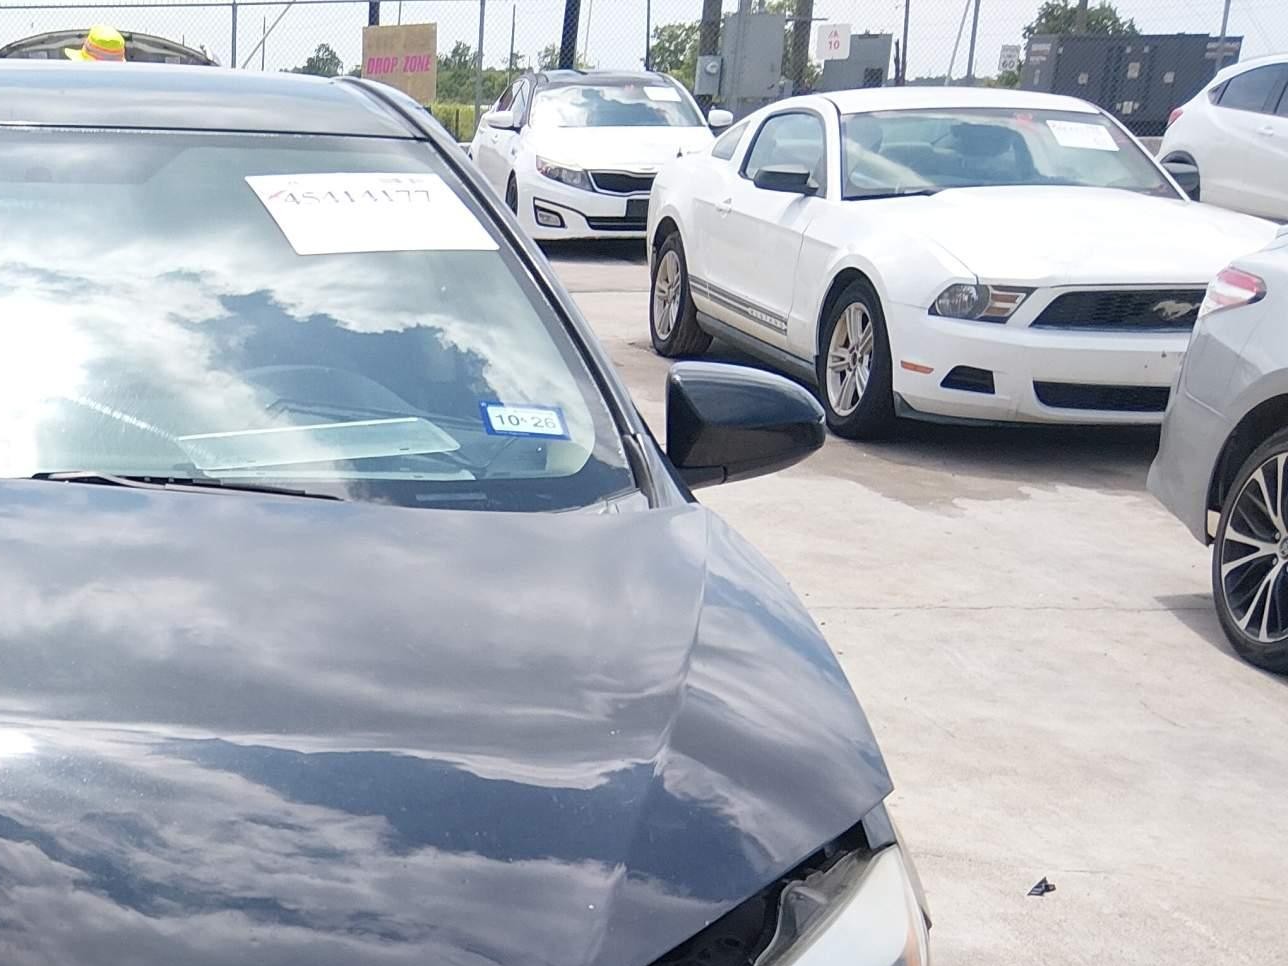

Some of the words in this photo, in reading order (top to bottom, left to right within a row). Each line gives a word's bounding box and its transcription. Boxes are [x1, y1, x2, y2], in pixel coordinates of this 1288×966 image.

[828, 40, 840, 50] 10
[366, 56, 398, 74] DROP
[403, 54, 432, 73] ZONE
[495, 414, 520, 426] 10
[532, 416, 557, 429] 26
